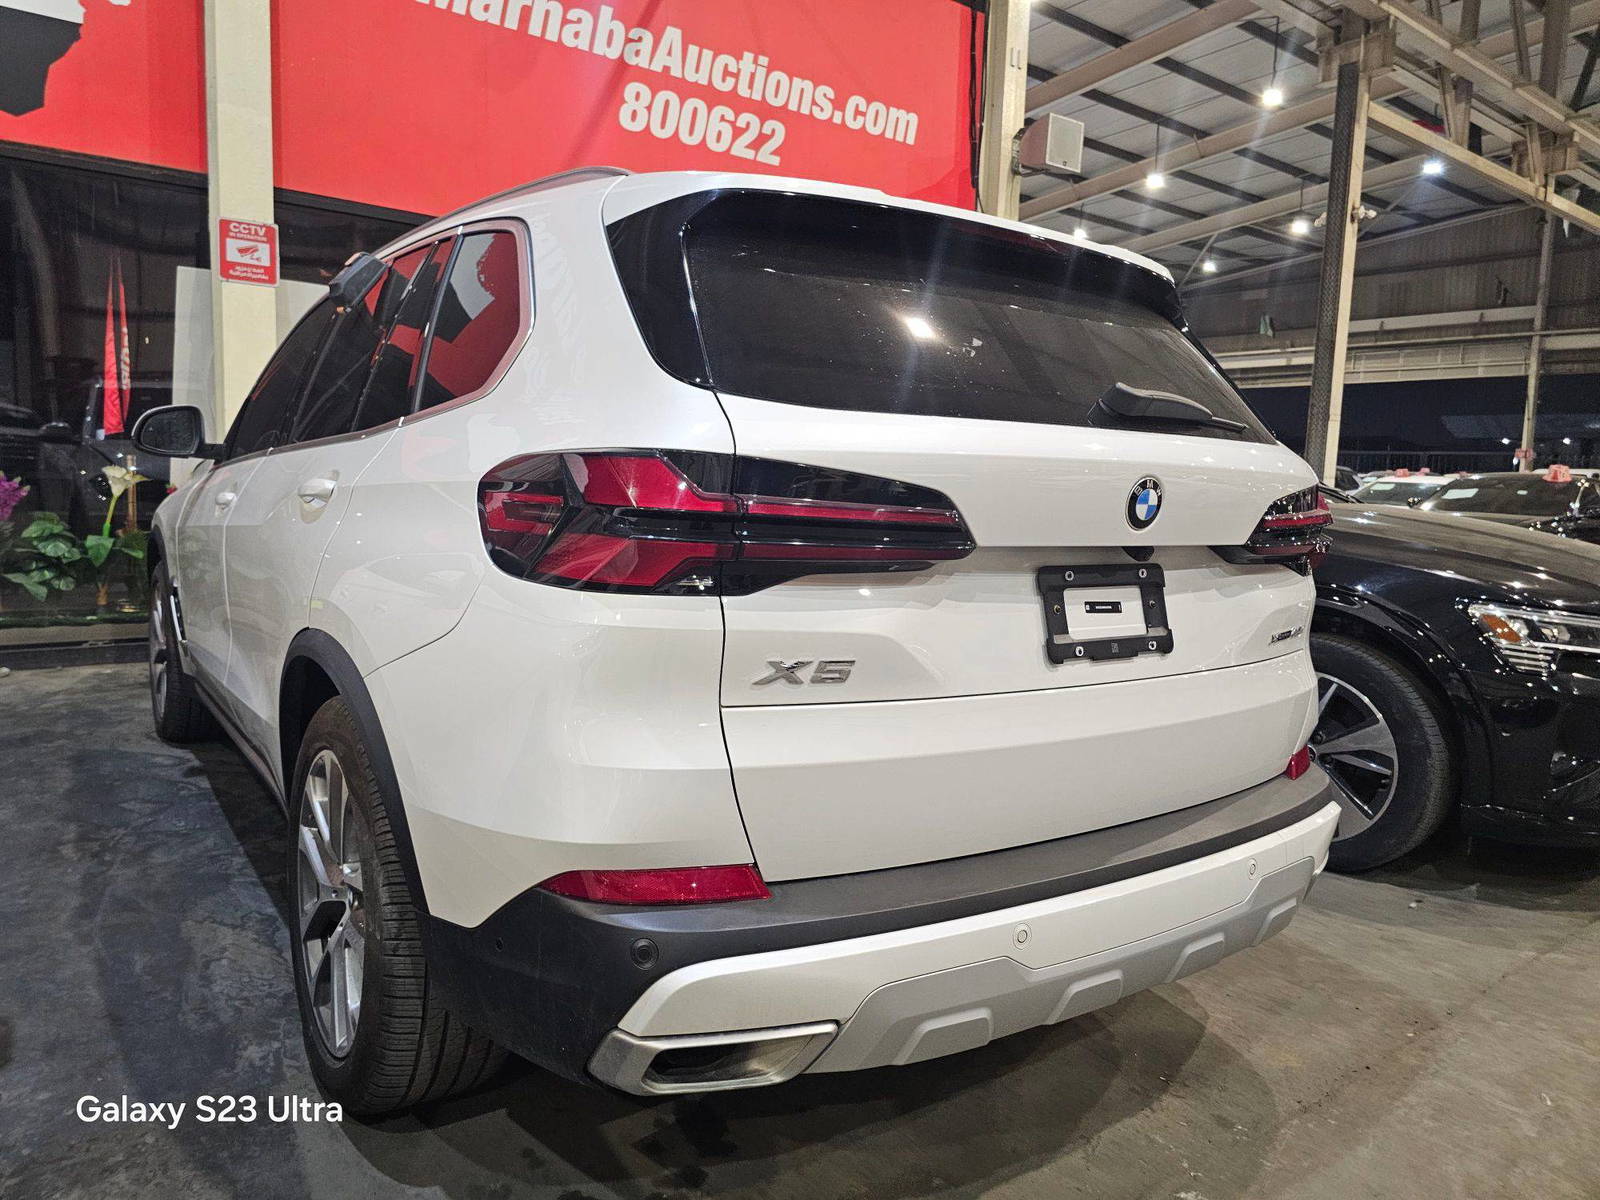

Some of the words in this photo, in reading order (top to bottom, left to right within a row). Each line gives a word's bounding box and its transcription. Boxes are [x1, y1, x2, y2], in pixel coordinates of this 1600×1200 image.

[415, 0, 919, 146] arhabaAuctions.com
[619, 82, 786, 166] 800622
[229, 222, 266, 236] CCTV
[1134, 479, 1162, 497] BMW
[752, 660, 856, 686] X5
